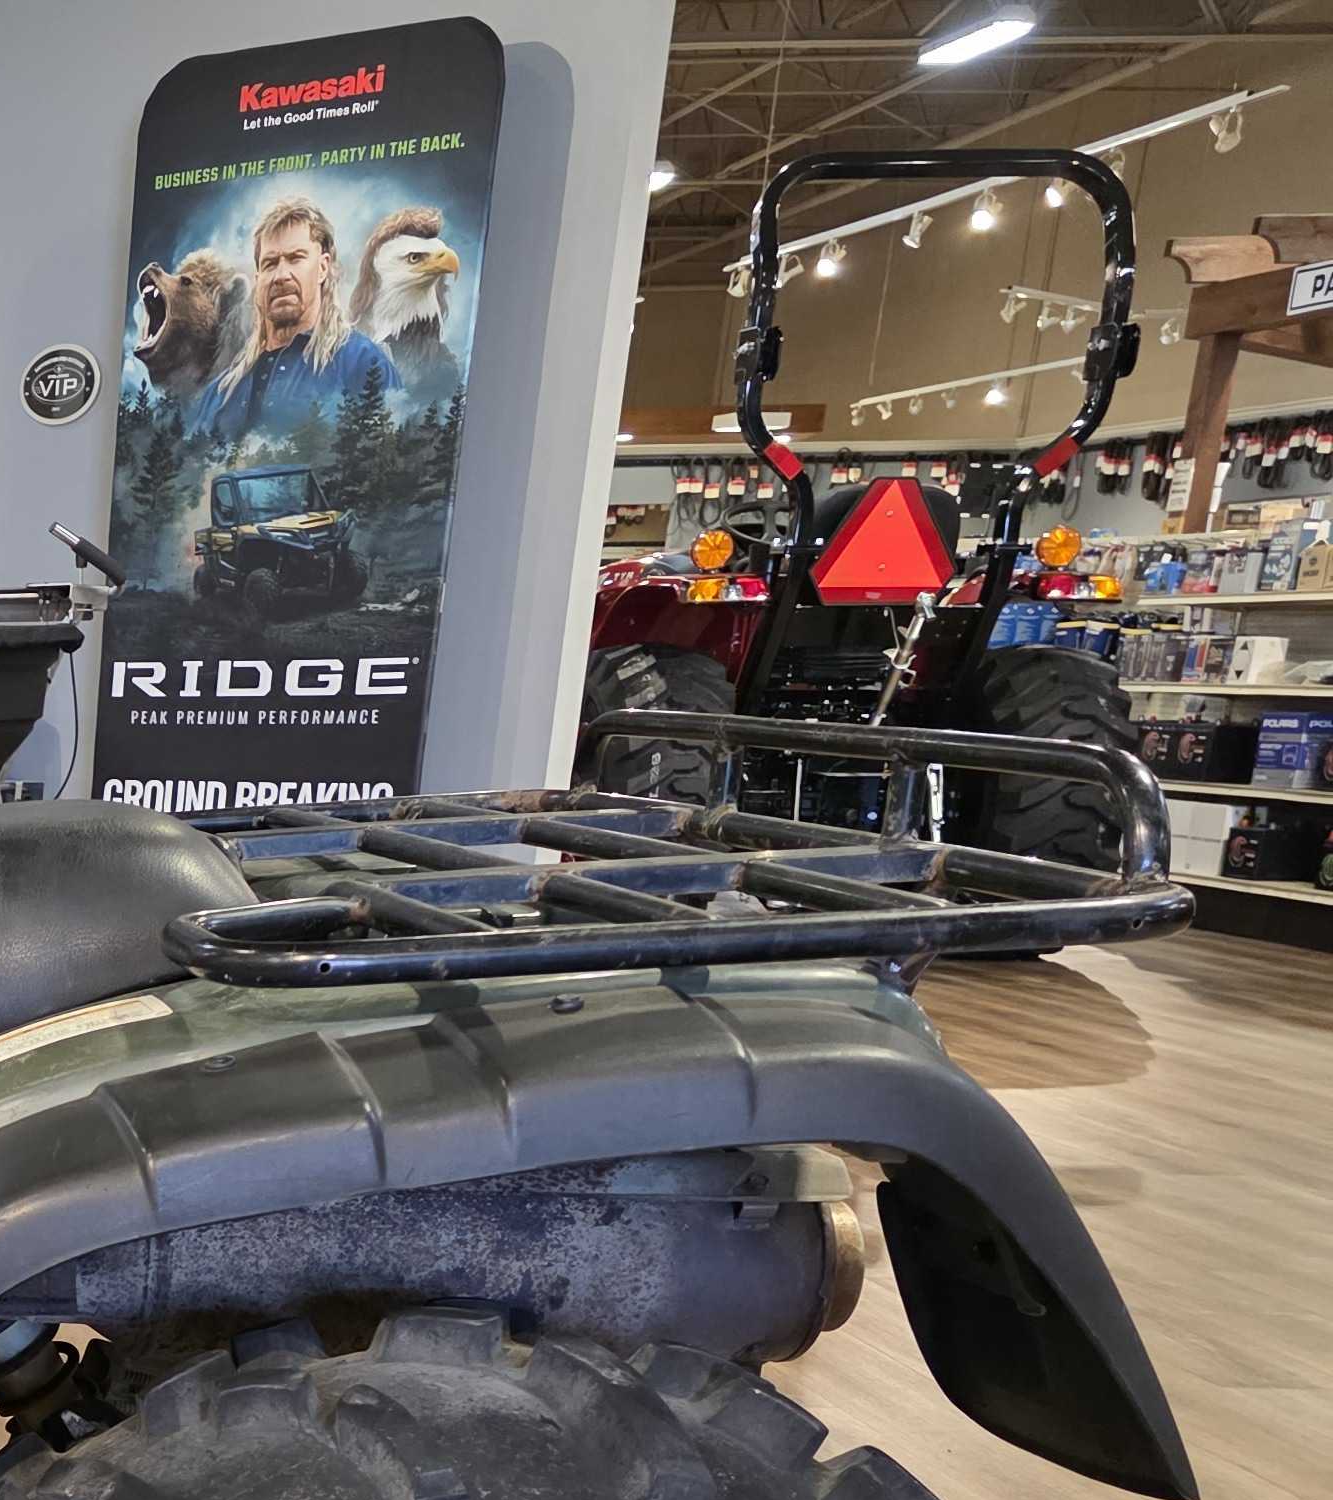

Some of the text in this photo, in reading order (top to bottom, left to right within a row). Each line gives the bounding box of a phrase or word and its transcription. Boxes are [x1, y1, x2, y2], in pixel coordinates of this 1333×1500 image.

[239, 64, 386, 113] Kawasaki
[243, 116, 261, 131] Let
[263, 112, 282, 127] the
[284, 107, 314, 125] Good
[315, 103, 350, 120] Times
[154, 132, 465, 191] BUSINESS IN THE FRONT. PARTY IN THE BACK.
[39, 379, 78, 397] VIP
[111, 657, 411, 698] RIDGE
[131, 709, 380, 726] PEAK PREMIUM PERFORMANCE
